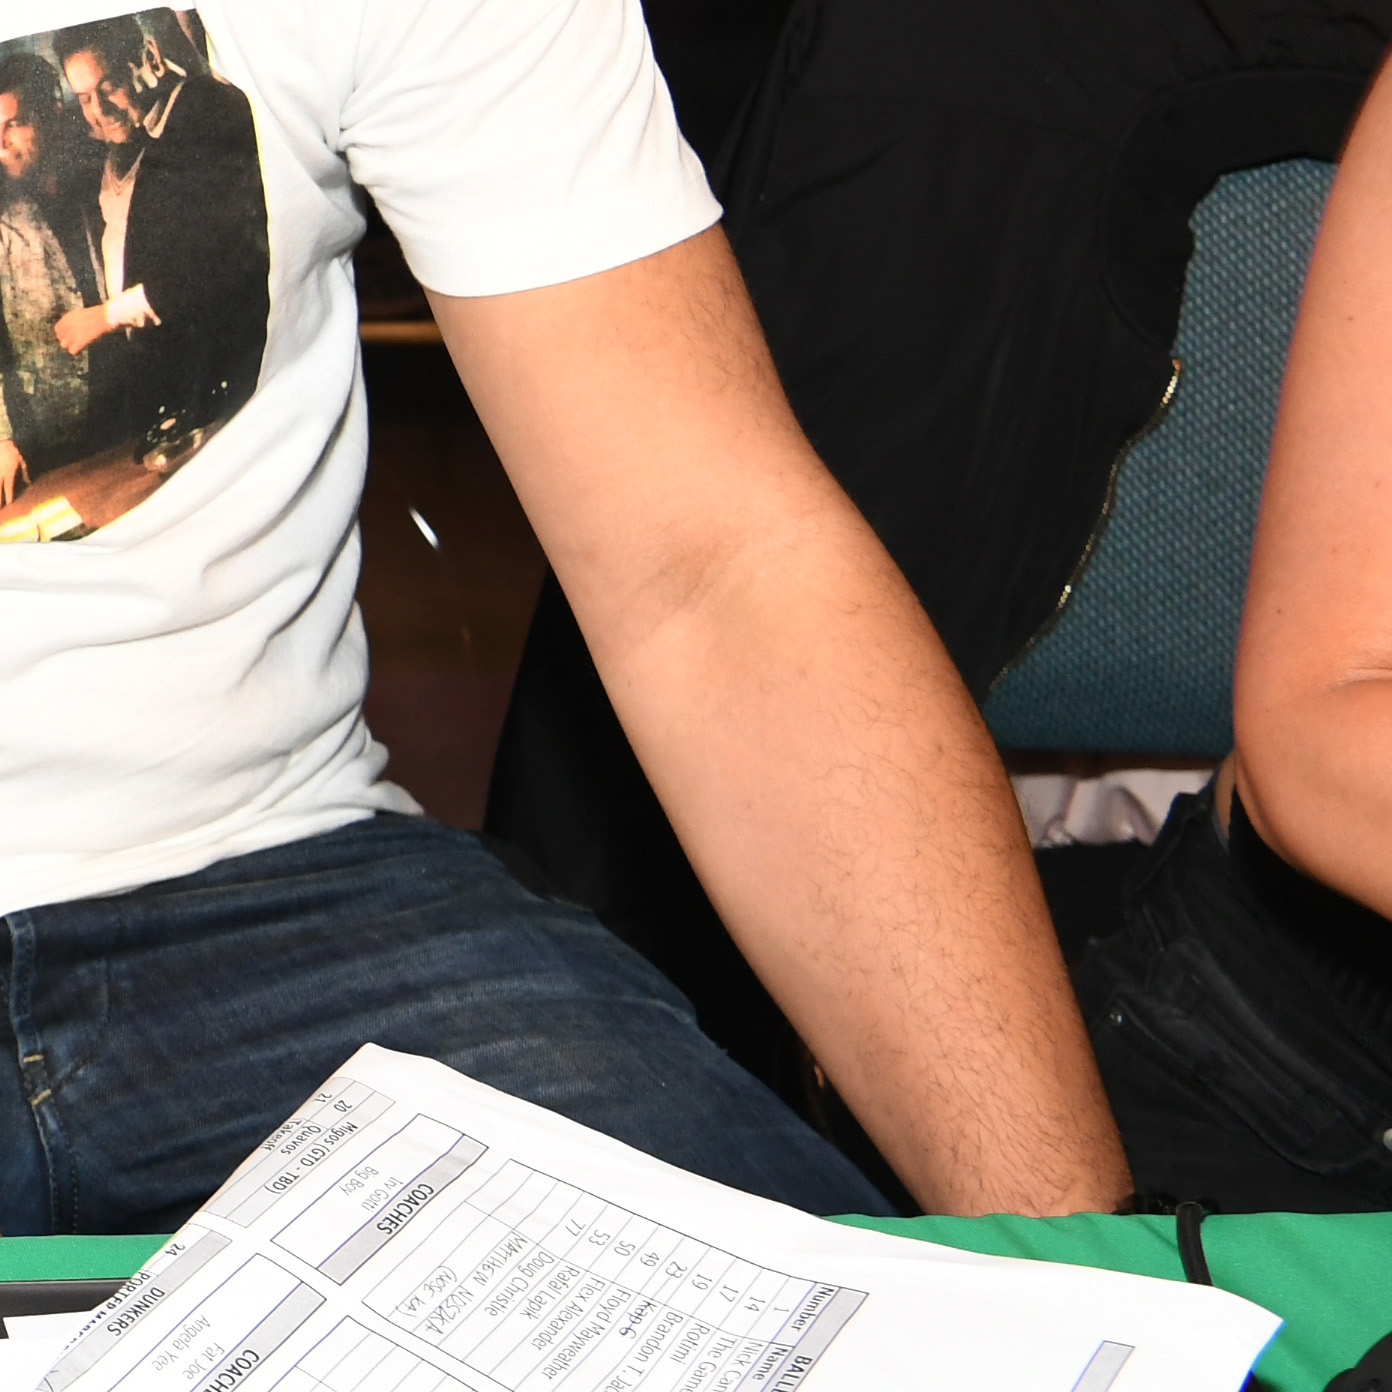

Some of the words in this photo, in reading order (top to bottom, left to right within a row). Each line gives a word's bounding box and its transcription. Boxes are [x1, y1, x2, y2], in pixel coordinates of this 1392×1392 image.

[333, 1099, 353, 1113] 20
[280, 1125, 322, 1156] Quavos
[324, 1121, 359, 1147] Migos
[300, 1142, 331, 1168] (GTD
[265, 1169, 300, 1195] TBD)
[338, 1177, 365, 1197] Boy
[355, 1166, 379, 1184] Big
[384, 1176, 404, 1191] Irv
[361, 1188, 390, 1213] Gotti
[376, 1183, 435, 1235] COACHES
[565, 1218, 586, 1237] 77
[588, 1229, 611, 1246] 53
[165, 1243, 186, 1257] 24
[473, 1230, 529, 1287] MATTHEW
[613, 1240, 637, 1257] 50
[640, 1252, 660, 1267] 49
[518, 1251, 555, 1279] Doug
[665, 1261, 688, 1279] 23
[548, 1265, 581, 1297] Rafal
[575, 1277, 606, 1303] Flex
[691, 1273, 713, 1290] 19
[719, 1284, 739, 1303] 17
[484, 1276, 529, 1317] Christie
[519, 1290, 557, 1321] Lapik
[595, 1288, 632, 1324] Floyd
[744, 1296, 766, 1312] 14
[791, 1286, 835, 1332] Number
[107, 1286, 166, 1337] DUNKERS
[627, 1300, 658, 1325] Kap
[172, 1314, 211, 1350] Angela
[531, 1300, 584, 1351] Alexander
[634, 1311, 684, 1363] Brandon
[200, 1342, 225, 1362] Fat
[541, 1321, 606, 1380] Mayweather
[669, 1322, 711, 1365] Rotimi
[707, 1337, 738, 1359] The
[735, 1341, 764, 1367] Nick
[151, 1349, 180, 1372] Yee
[182, 1358, 207, 1380] Joe
[623, 1364, 645, 1377] T.
[752, 1346, 789, 1381] Name
